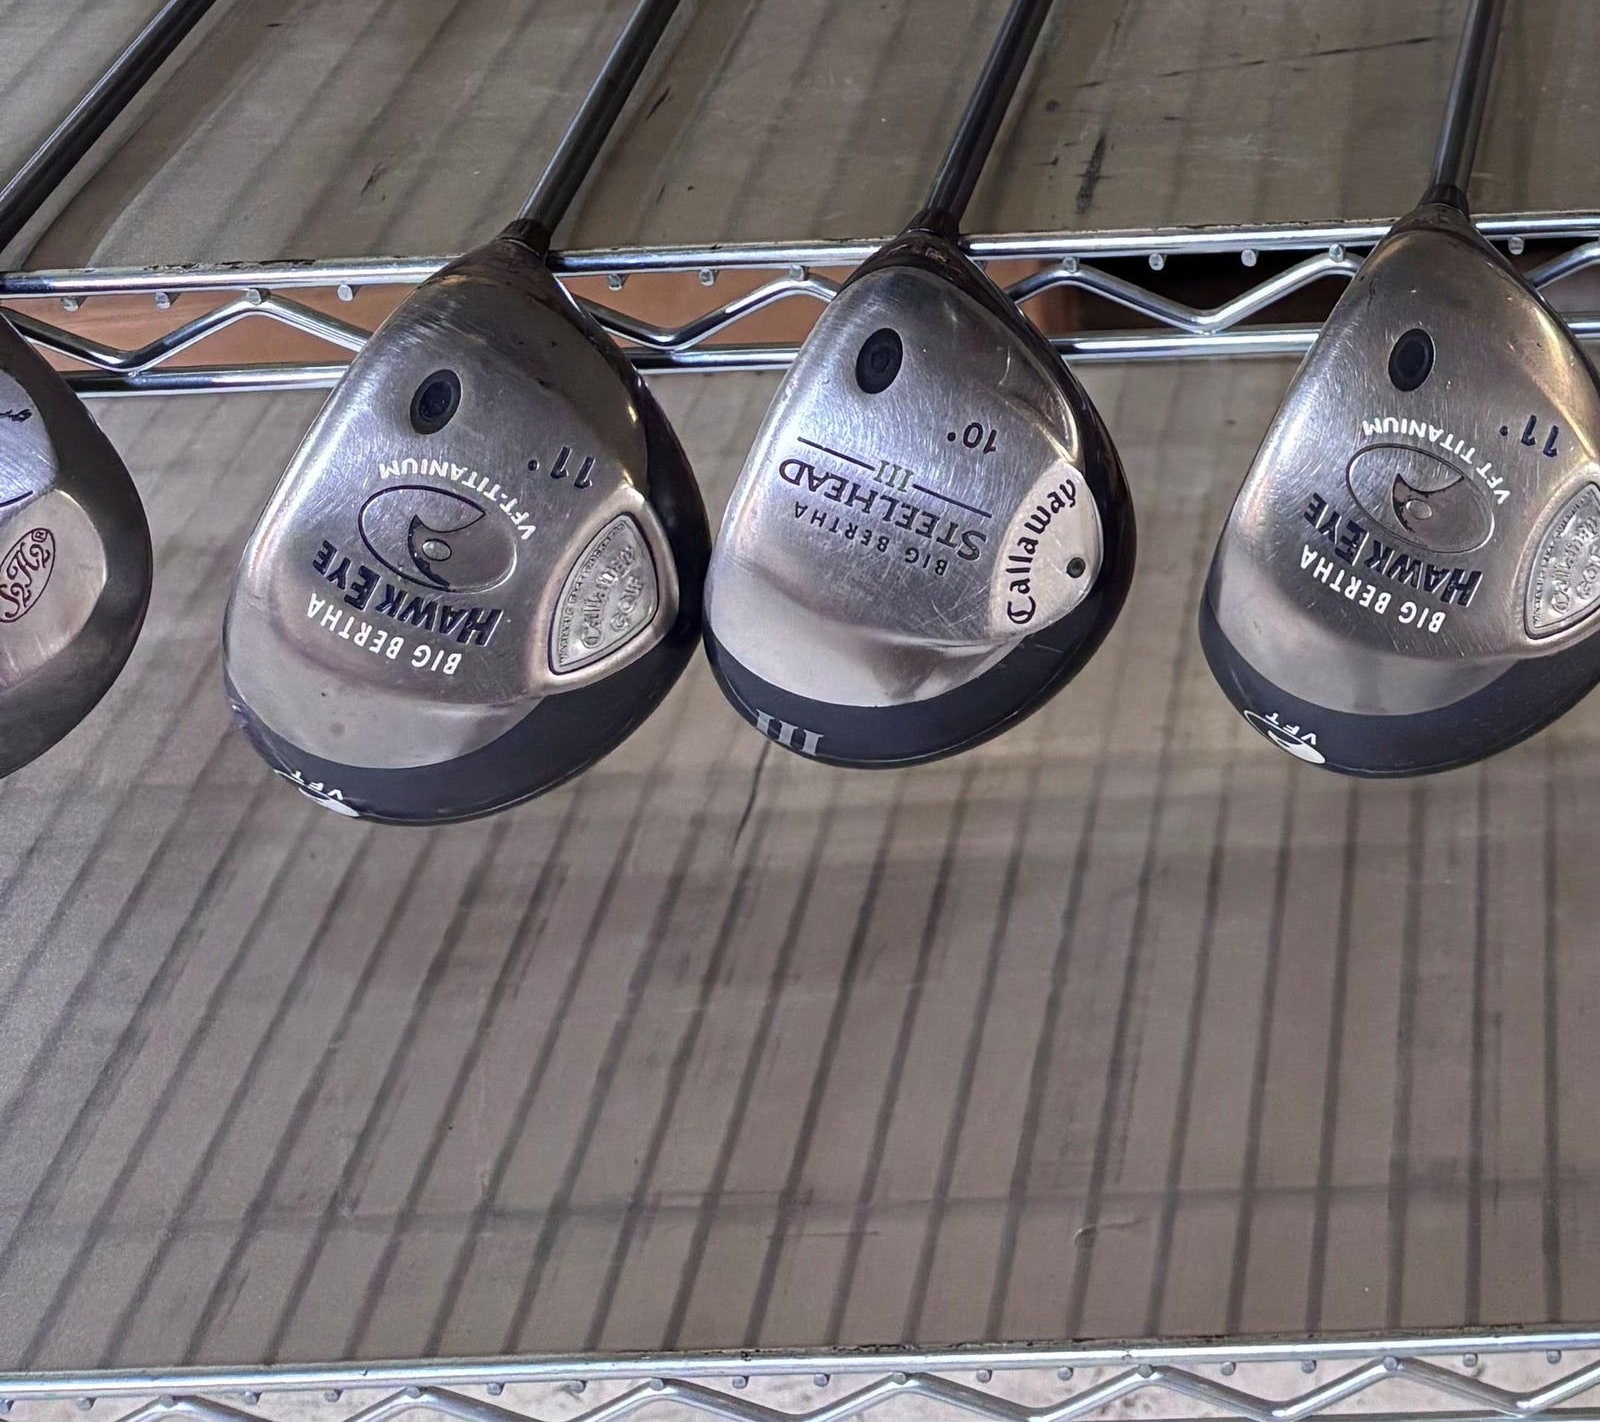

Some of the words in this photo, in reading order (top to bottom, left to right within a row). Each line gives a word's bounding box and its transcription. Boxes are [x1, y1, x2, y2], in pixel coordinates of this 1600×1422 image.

[946, 420, 998, 455] 10°
[1362, 416, 1477, 465] TITANIUM
[1475, 462, 1510, 505] VFT
[777, 456, 989, 563] STEELHEAD
[792, 500, 890, 554] BERTHA
[903, 545, 949, 577] BIG
[1006, 477, 1077, 626] Callaway
[1298, 543, 1390, 614] BERTHA
[307, 592, 406, 659] BERTHA
[1399, 599, 1447, 634] BIG
[412, 641, 463, 677] BIG
[756, 708, 824, 756] III
[1265, 710, 1318, 747] VFT
[290, 767, 345, 802] VFT
